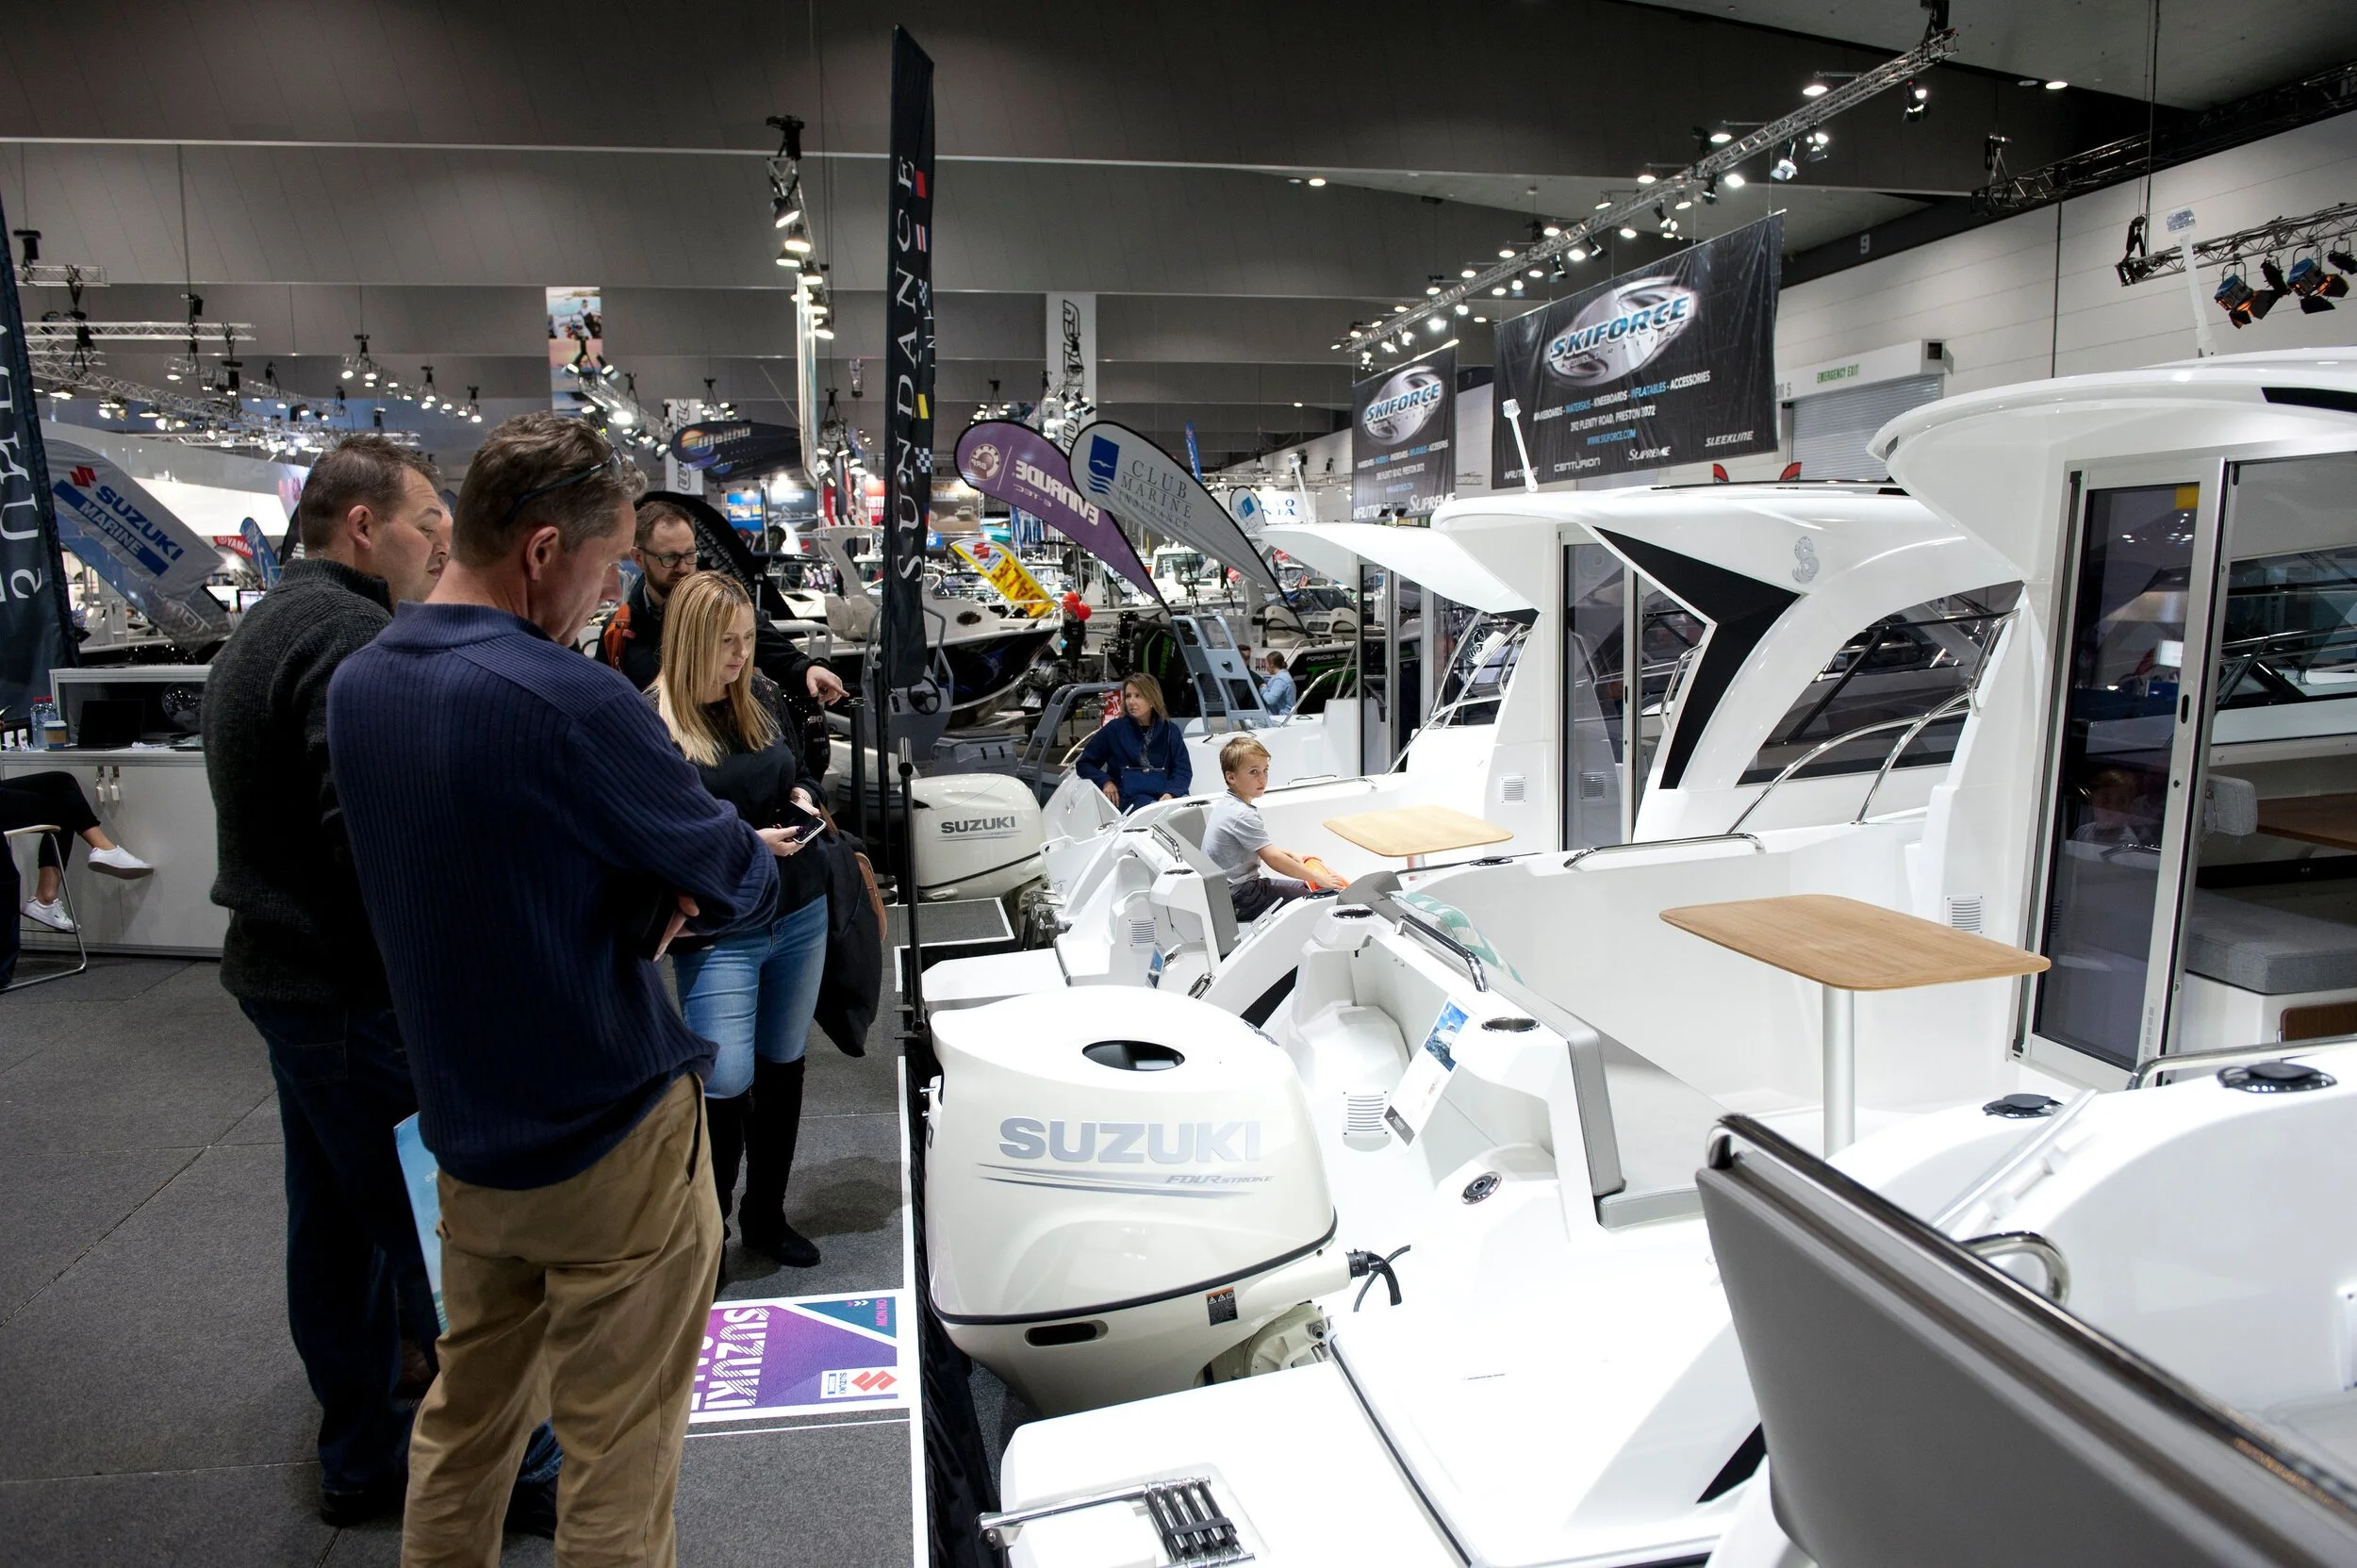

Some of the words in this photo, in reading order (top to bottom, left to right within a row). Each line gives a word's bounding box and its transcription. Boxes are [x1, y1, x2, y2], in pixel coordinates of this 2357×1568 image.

[1860, 234, 1870, 255] 9
[1549, 292, 1691, 362] SKIFORCE
[897, 156, 923, 582] SUNDANCE
[1817, 367, 1846, 384] EMERGENCY
[1847, 364, 1859, 378] EXIT
[1366, 380, 1442, 425] SKIFORCE
[1593, 390, 1628, 407] KNEEBOARDS
[1670, 371, 1711, 390] ACCESSORIES
[1580, 417, 1598, 430] PLENTY
[1615, 407, 1640, 422] PRESTON
[1628, 446, 1672, 461] SUPREME
[1705, 430, 1755, 447] SLEEKLINE
[1131, 460, 1188, 499] CLUB
[1555, 456, 1601, 473] CENTURION
[1117, 491, 1190, 531] INSURANCE
[1121, 474, 1193, 519] MARINE
[78, 501, 145, 555] MARINE
[95, 485, 185, 561] SUZUKI
[941, 816, 1016, 834] SUZUKI
[998, 1115, 1262, 1164] SUZUKI
[1164, 1175, 1222, 1185] FOUR
[1221, 1175, 1275, 1185] STROKE
[876, 1309, 888, 1327] NOW
[704, 1307, 770, 1410] SUZUKI
